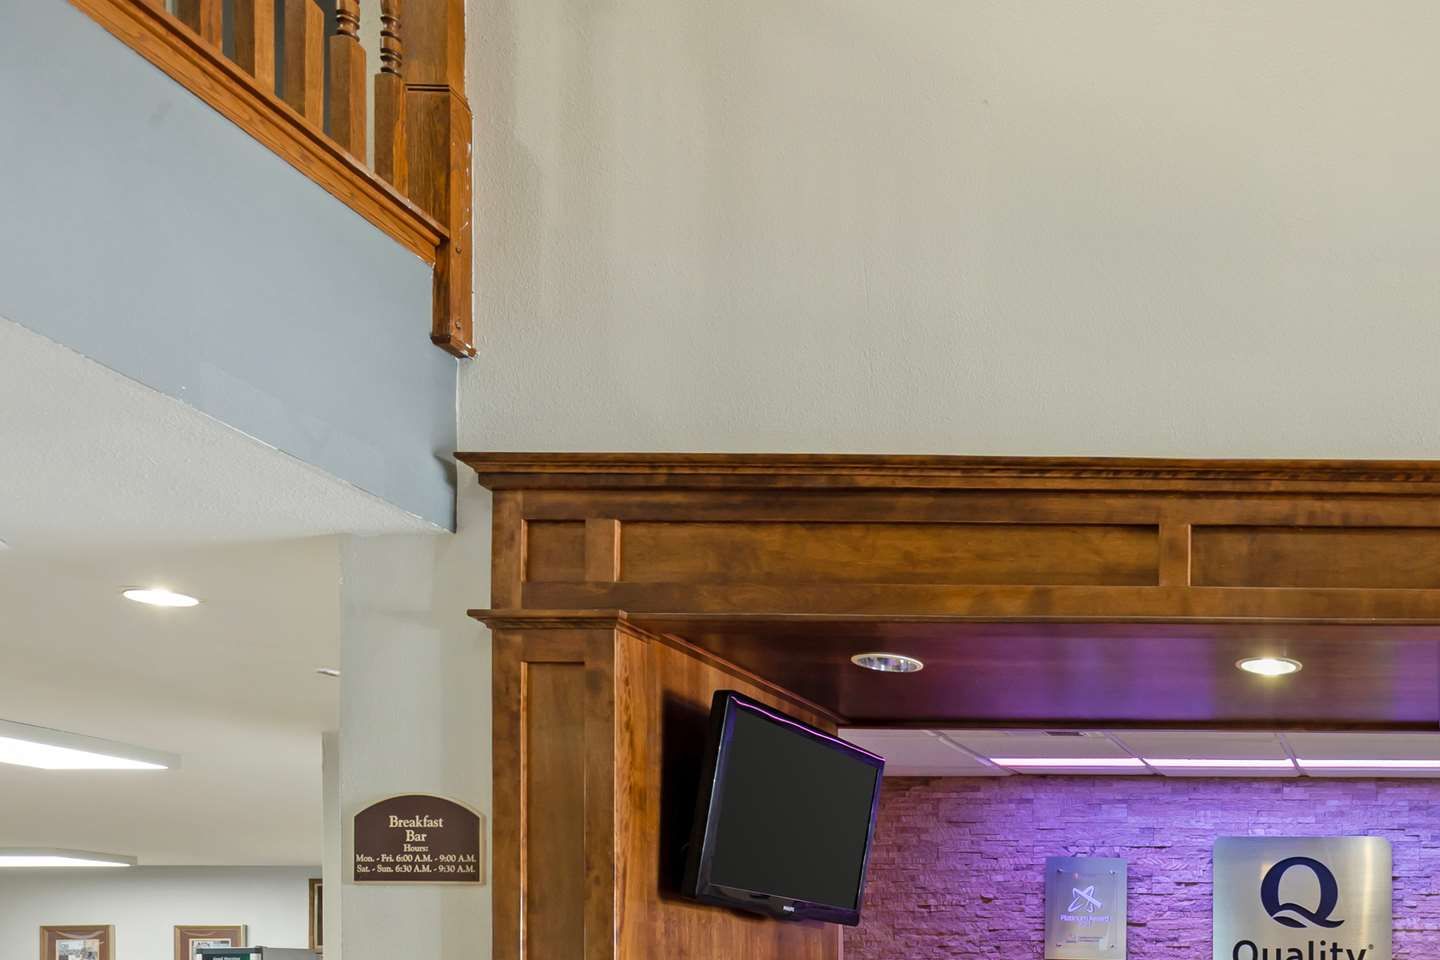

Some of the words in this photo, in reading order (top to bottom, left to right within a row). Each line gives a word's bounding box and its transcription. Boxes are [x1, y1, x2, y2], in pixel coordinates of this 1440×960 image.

[388, 815, 443, 828] Breakfast
[405, 830, 427, 842] Bar
[403, 844, 429, 852] Hours:
[356, 854, 375, 862] Mon.
[381, 854, 394, 862] Fri.
[396, 854, 413, 862] 6:00
[414, 854, 433, 862] A.M.
[439, 854, 456, 862] 9:00
[458, 854, 476, 862] A.M.
[356, 865, 370, 873] Sat.
[377, 865, 394, 873] Sun.
[395, 865, 412, 873] 6:30
[413, 865, 432, 873] A.M.
[438, 865, 456, 873] 9:30
[457, 865, 475, 873] A.M.
[1260, 856, 1345, 928] Q
